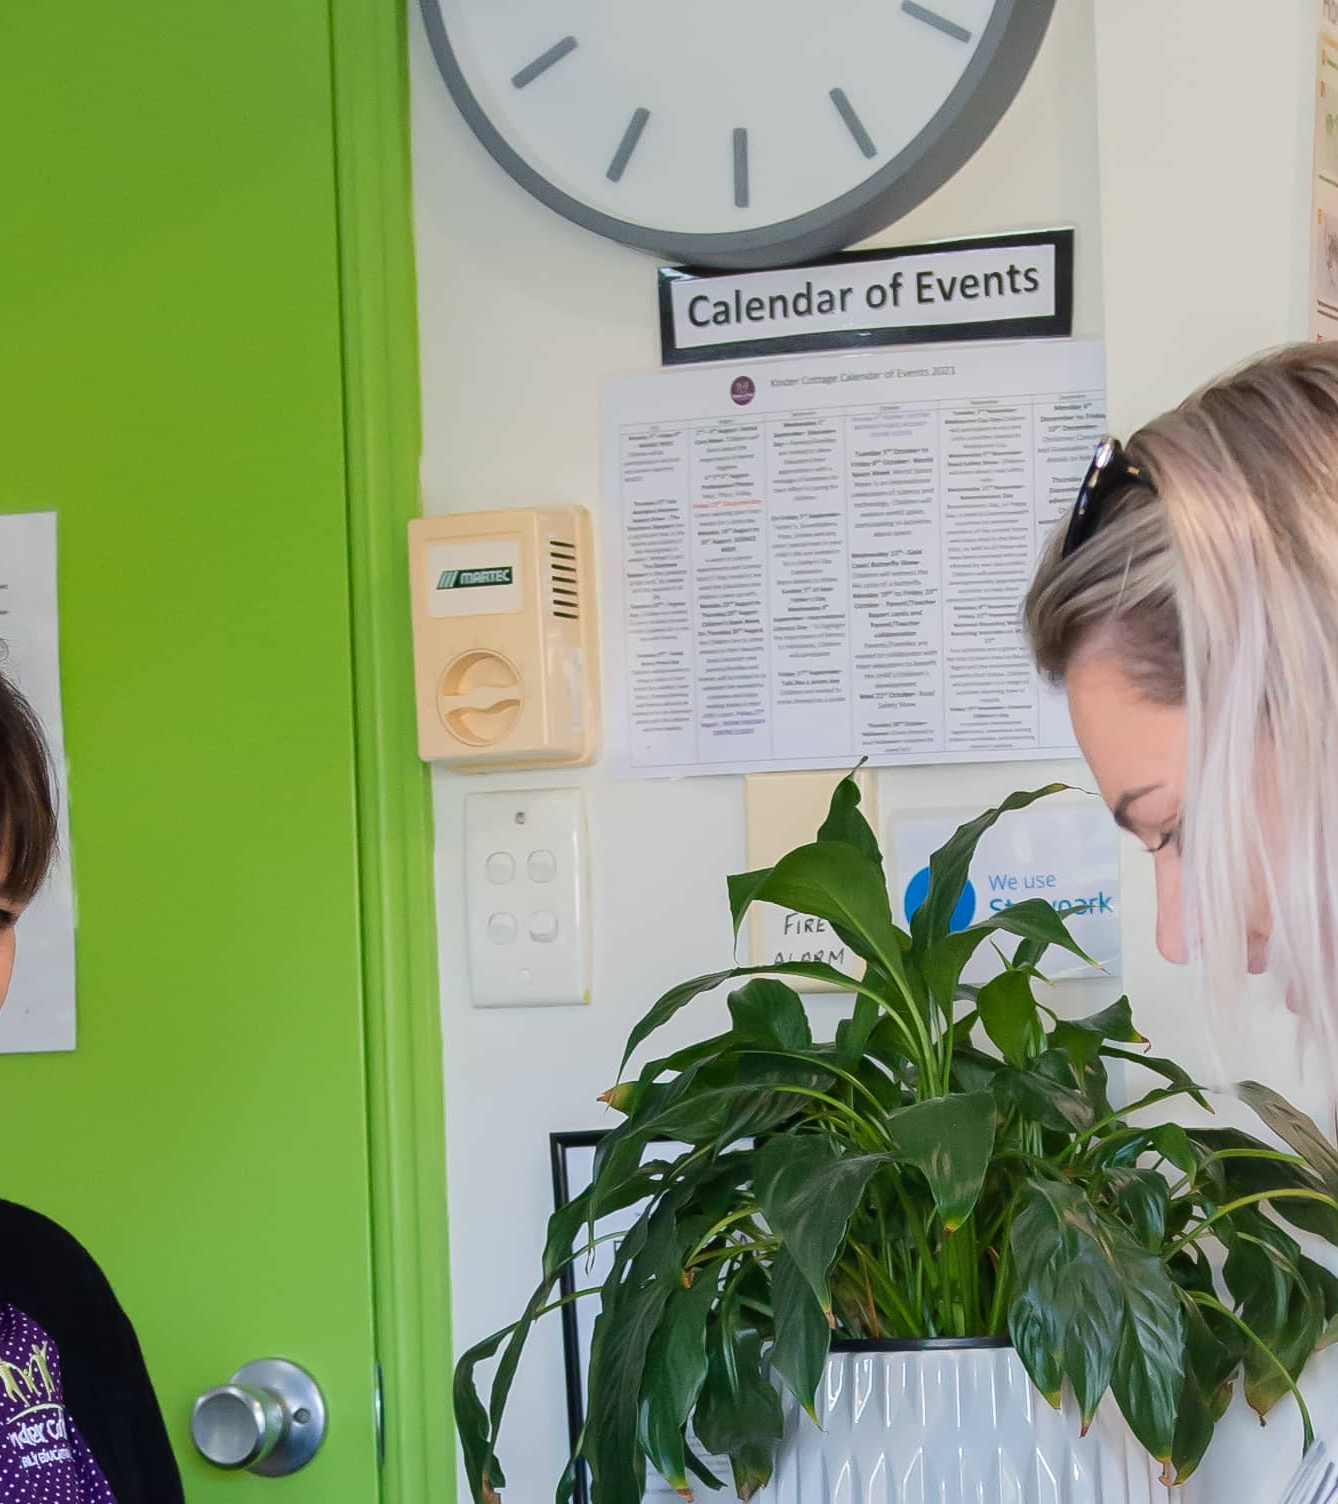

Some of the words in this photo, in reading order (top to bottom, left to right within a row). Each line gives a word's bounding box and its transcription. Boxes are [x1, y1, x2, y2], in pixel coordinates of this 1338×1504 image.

[687, 281, 853, 328] Calendar
[865, 271, 904, 310] of
[915, 263, 1040, 305] Events
[459, 568, 511, 585] MARTEC
[988, 874, 1018, 891] We
[1024, 873, 1057, 889] use
[784, 912, 826, 936] FIRE
[8, 1422, 49, 1450] nder
